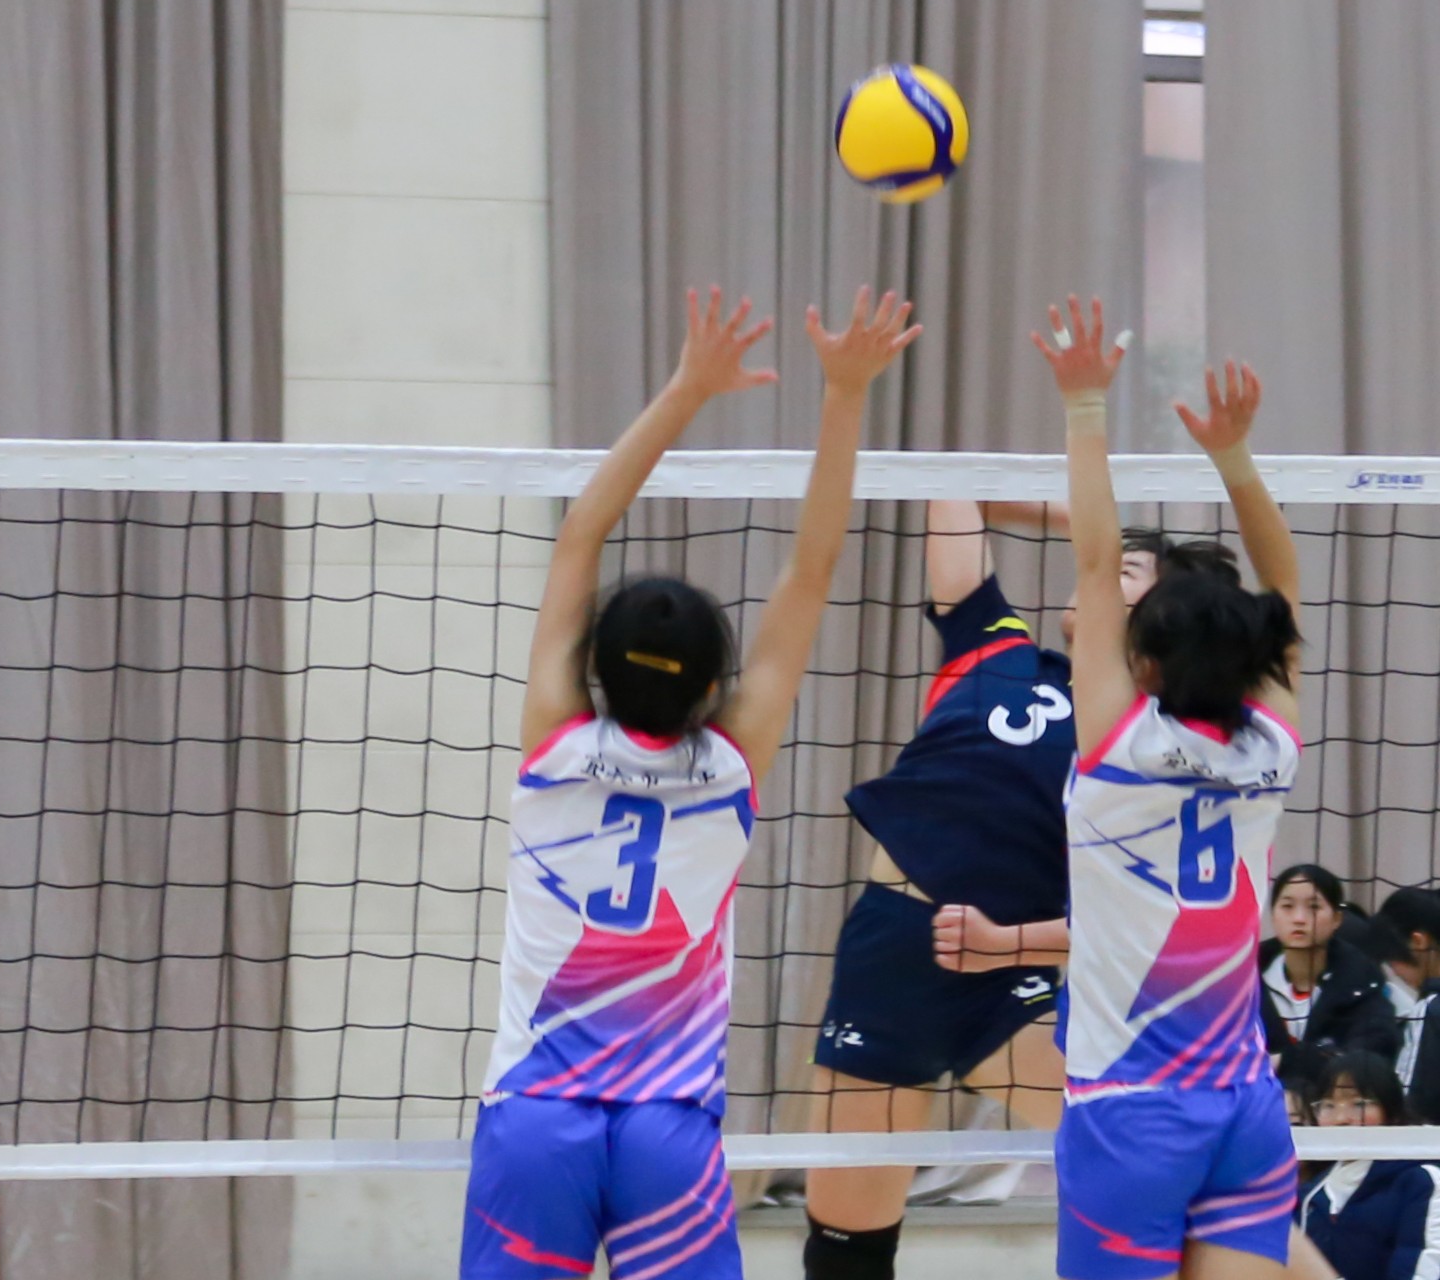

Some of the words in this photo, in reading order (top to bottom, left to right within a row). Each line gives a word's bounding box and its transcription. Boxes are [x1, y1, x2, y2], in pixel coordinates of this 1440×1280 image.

[988, 684, 1072, 746] 3
[585, 792, 665, 930] 3
[1177, 789, 1235, 902] 6
